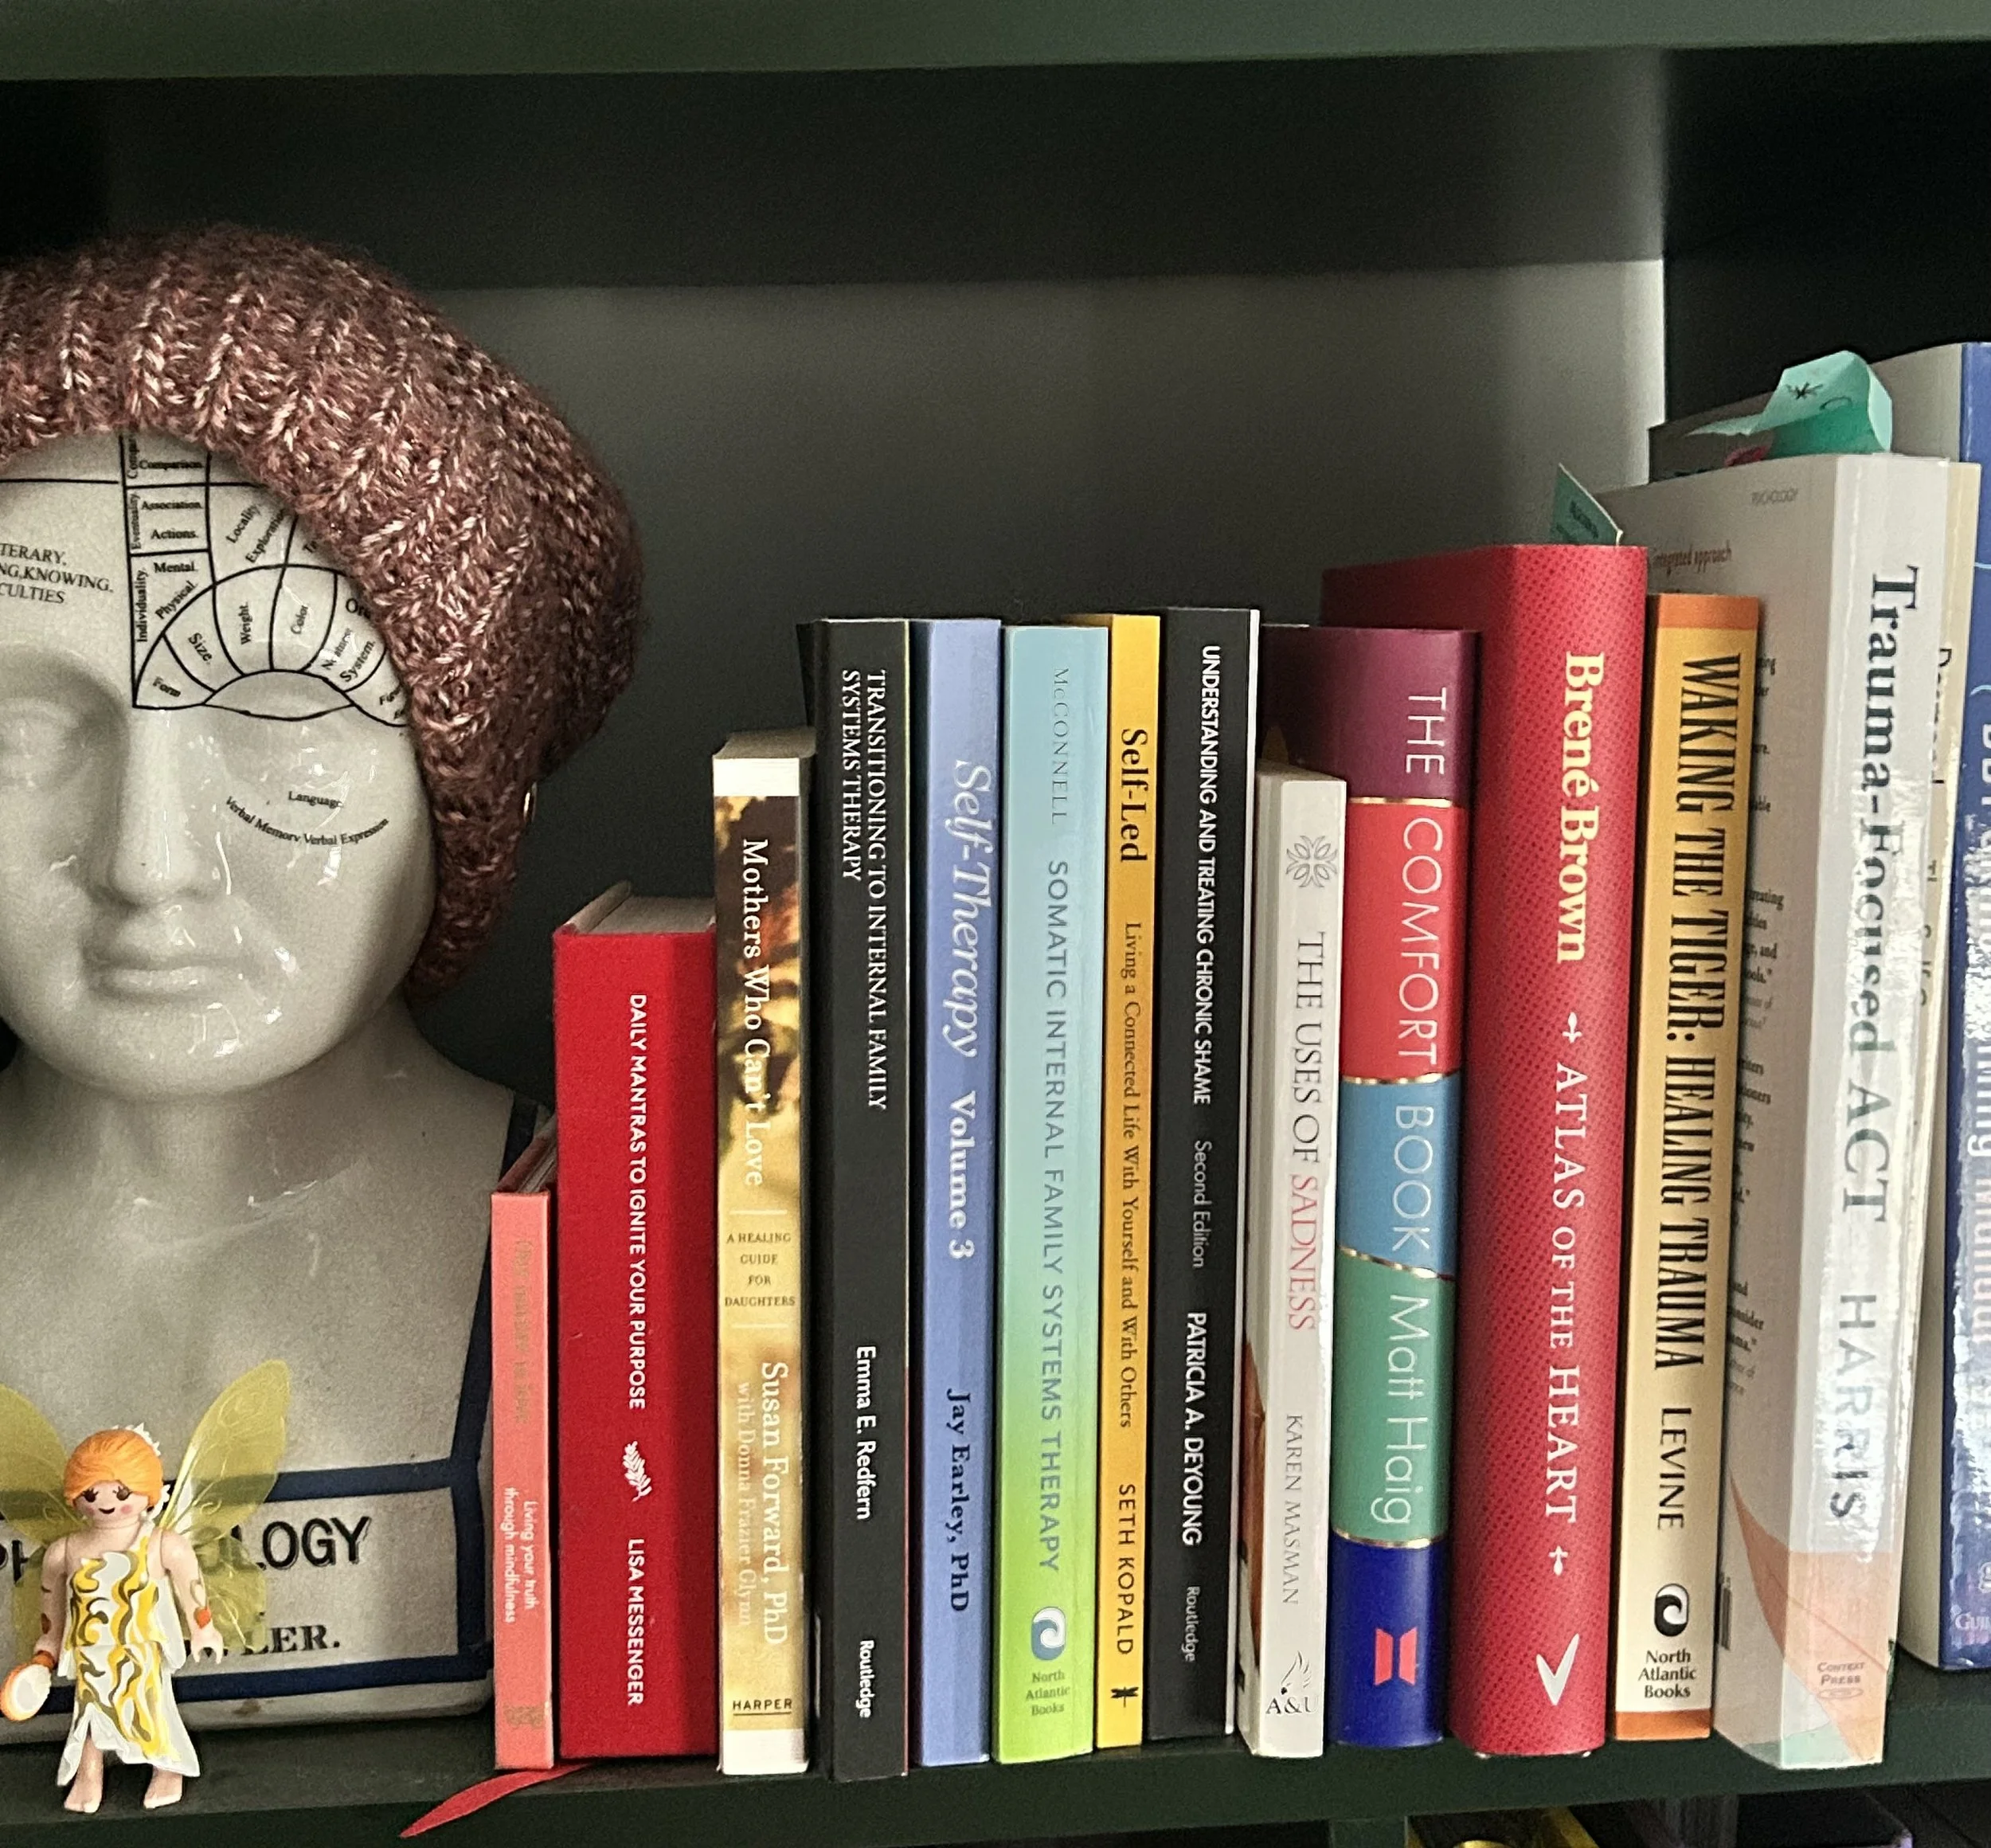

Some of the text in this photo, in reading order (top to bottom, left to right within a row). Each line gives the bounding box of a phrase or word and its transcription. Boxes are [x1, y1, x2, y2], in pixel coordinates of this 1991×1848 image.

[226, 796, 256, 824] Verbal
[254, 818, 300, 842] Memory
[303, 833, 337, 845] Verbal
[842, 669, 862, 882] SYSTEMS THERAPY
[1120, 729, 1148, 862] Self-Led
[1557, 651, 1606, 964] Brené Brown
[743, 839, 769, 959] Mothers
[867, 669, 887, 1110] TRANSITIONING TO INTERNAL FAMILY
[1193, 645, 1221, 1105] UNDERSTANDING AND TREATING CHRONIC SHAME
[744, 965, 771, 1030] Who
[943, 760, 993, 1259] Self-Therapy Volume 3
[1392, 687, 1447, 1251] THE COMFORT BOOK
[1654, 653, 1741, 1370] WAKING THE TIGER: HEALING TRAUMA
[745, 1121, 771, 1186] Love
[1121, 922, 1142, 1427] Living a Connected Life With Yourself and With Others
[1289, 930, 1326, 1331] THE USES OF SADNESS
[1843, 1079, 1891, 1223] ACT
[629, 995, 647, 1409] DAILY MANTRAS TO IGNITE YOUR PURPOSE
[726, 1232, 792, 1243] A HEALING
[740, 1254, 778, 1265] GUIDE
[1039, 860, 1069, 1572] SOMATIC INTERNAL FAMILY SYSTEMS THERAPY
[1192, 1140, 1213, 1268] Second Edition
[725, 1296, 796, 1307] DAUGHTERS
[748, 1274, 772, 1286] FOR
[1545, 1061, 1588, 1525] ATLAS OF THE HEART
[737, 1382, 756, 1423] with
[737, 1430, 757, 1491] Donna
[856, 1345, 876, 1521] Emma E. Redfern
[1182, 1312, 1207, 1547] PATRICIA A. DEYOUNG
[1370, 1294, 1430, 1525] Matt Haig
[1830, 1294, 1876, 1517] HARRIS
[737, 1498, 756, 1564] Frazier
[761, 1362, 789, 1645] Susan Forward, PhD
[945, 1388, 971, 1611] Jay Earley, PhD
[1282, 1414, 1305, 1606] KAREN MASMAN
[1657, 1408, 1692, 1530] LEVINE
[500, 1487, 519, 1623] through mindfulness
[520, 1545, 535, 1575] your
[524, 1580, 538, 1609] truth
[1117, 1484, 1136, 1654] SETH KOPALD
[627, 1539, 644, 1705] LISA MESSENGER
[855, 1639, 874, 1718] Routledge
[1032, 1669, 1066, 1683] North
[1181, 1586, 1200, 1662] Routledge
[1638, 1666, 1697, 1682] Atlantic
[1646, 1650, 1692, 1664] North
[732, 1698, 793, 1711] HARPER
[1026, 1686, 1071, 1701] Atlantic
[1032, 1702, 1065, 1717] Books
[1644, 1684, 1691, 1699] Books
